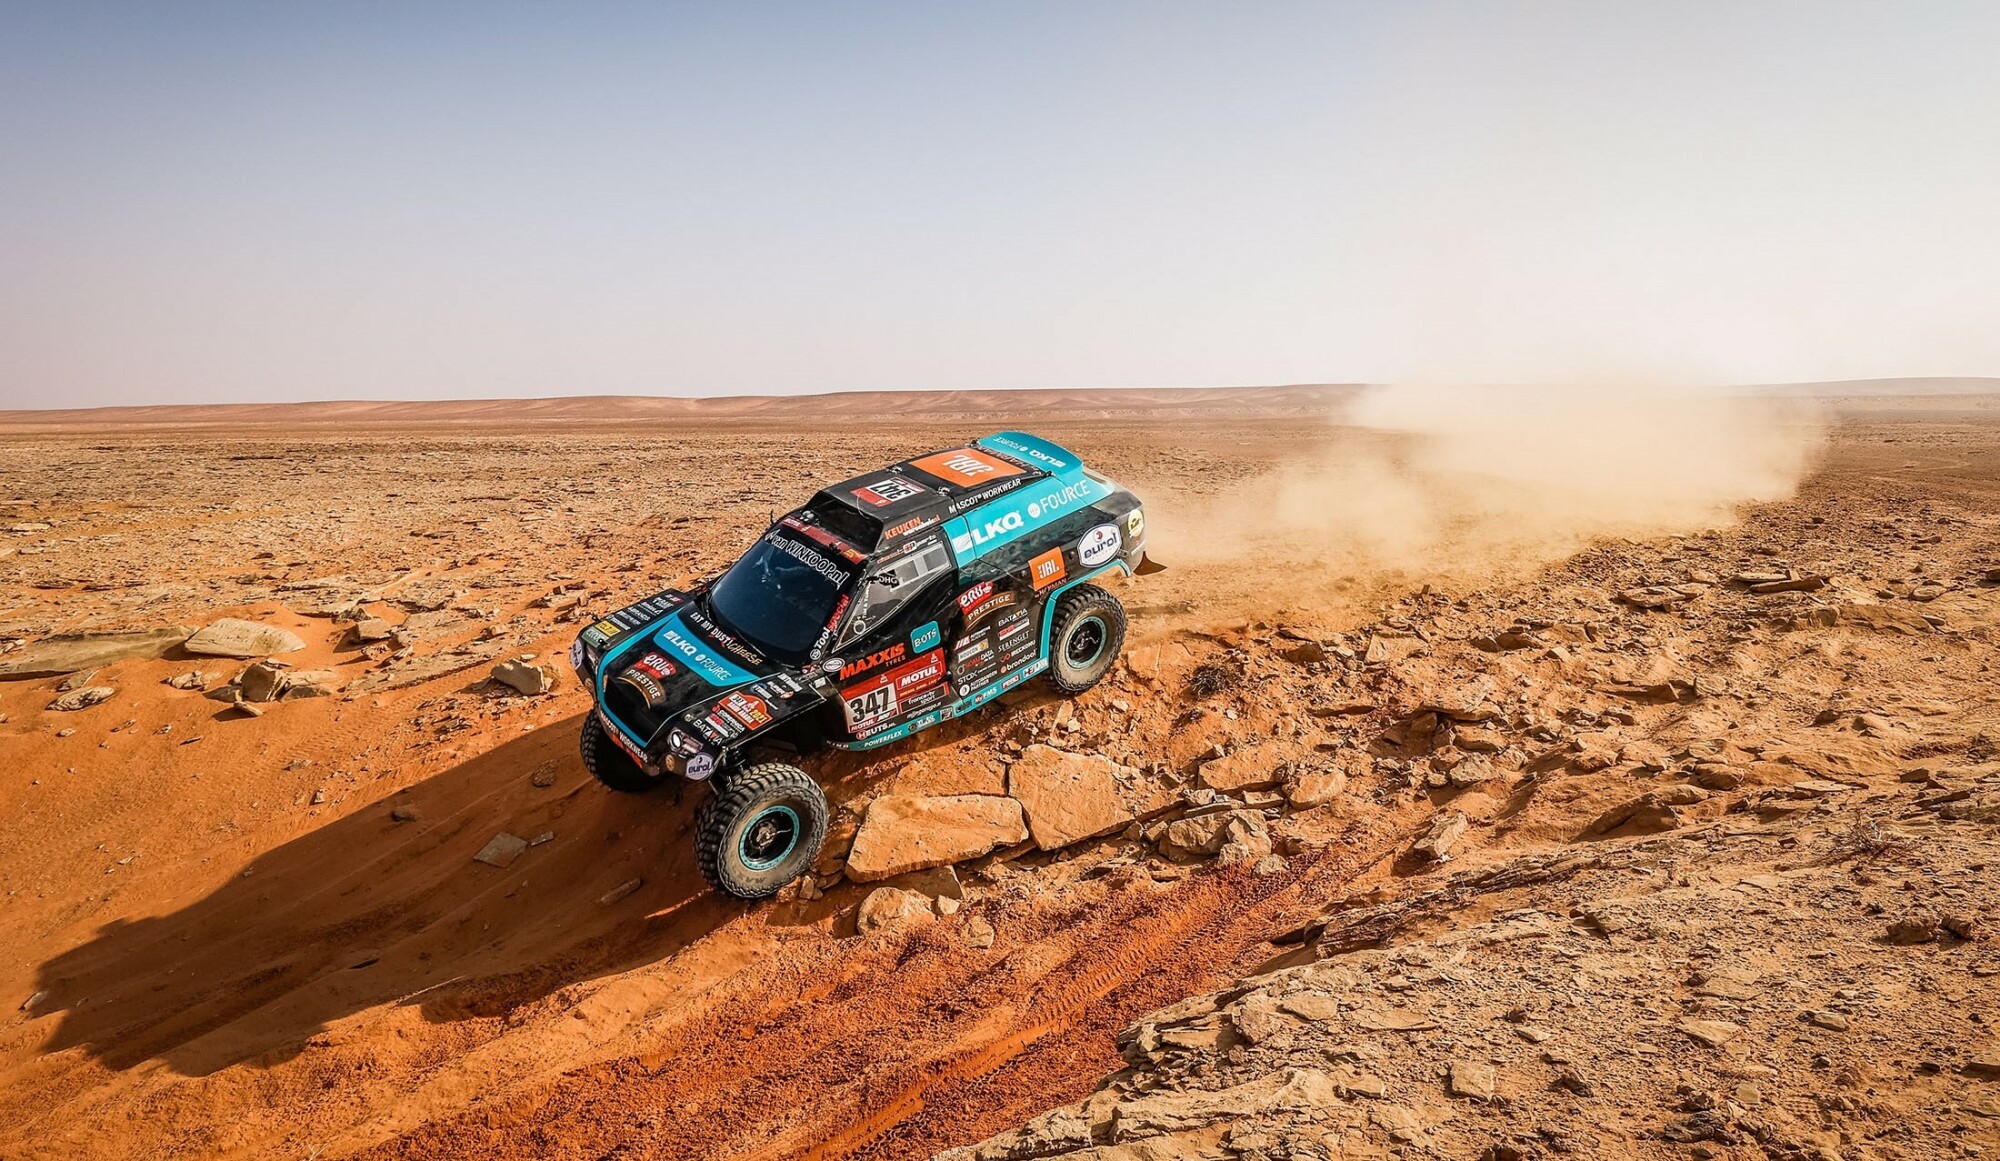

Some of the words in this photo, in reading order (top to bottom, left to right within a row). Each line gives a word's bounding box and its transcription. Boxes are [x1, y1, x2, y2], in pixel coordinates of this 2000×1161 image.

[942, 454, 995, 477] JBL
[1029, 449, 1056, 466] LKQ
[869, 482, 912, 500] 347
[983, 478, 1022, 500] WORKWEAR
[971, 510, 1025, 545] LKQ
[1039, 480, 1091, 514] FOURCE
[884, 516, 922, 540] KEUKEN
[1083, 532, 1119, 560] eurol
[772, 533, 787, 550] van
[785, 540, 851, 586] WINKOOP.nl
[1037, 558, 1060, 580] JBL
[967, 594, 1011, 621] PRESTIGE
[690, 612, 705, 624] EAT
[700, 620, 715, 631] MY
[913, 628, 937, 648] BOTS
[673, 632, 698, 657] LKQ
[701, 658, 732, 681] FOURCE
[728, 642, 763, 666] CHEESE
[840, 642, 906, 681] MAXXIS
[885, 656, 907, 668] TYRES
[626, 669, 662, 699] PRESTIGE
[901, 665, 938, 687] MOTUL
[958, 670, 978, 685] STOX
[850, 687, 890, 723] 347
[863, 729, 903, 748] POWERFLEX
